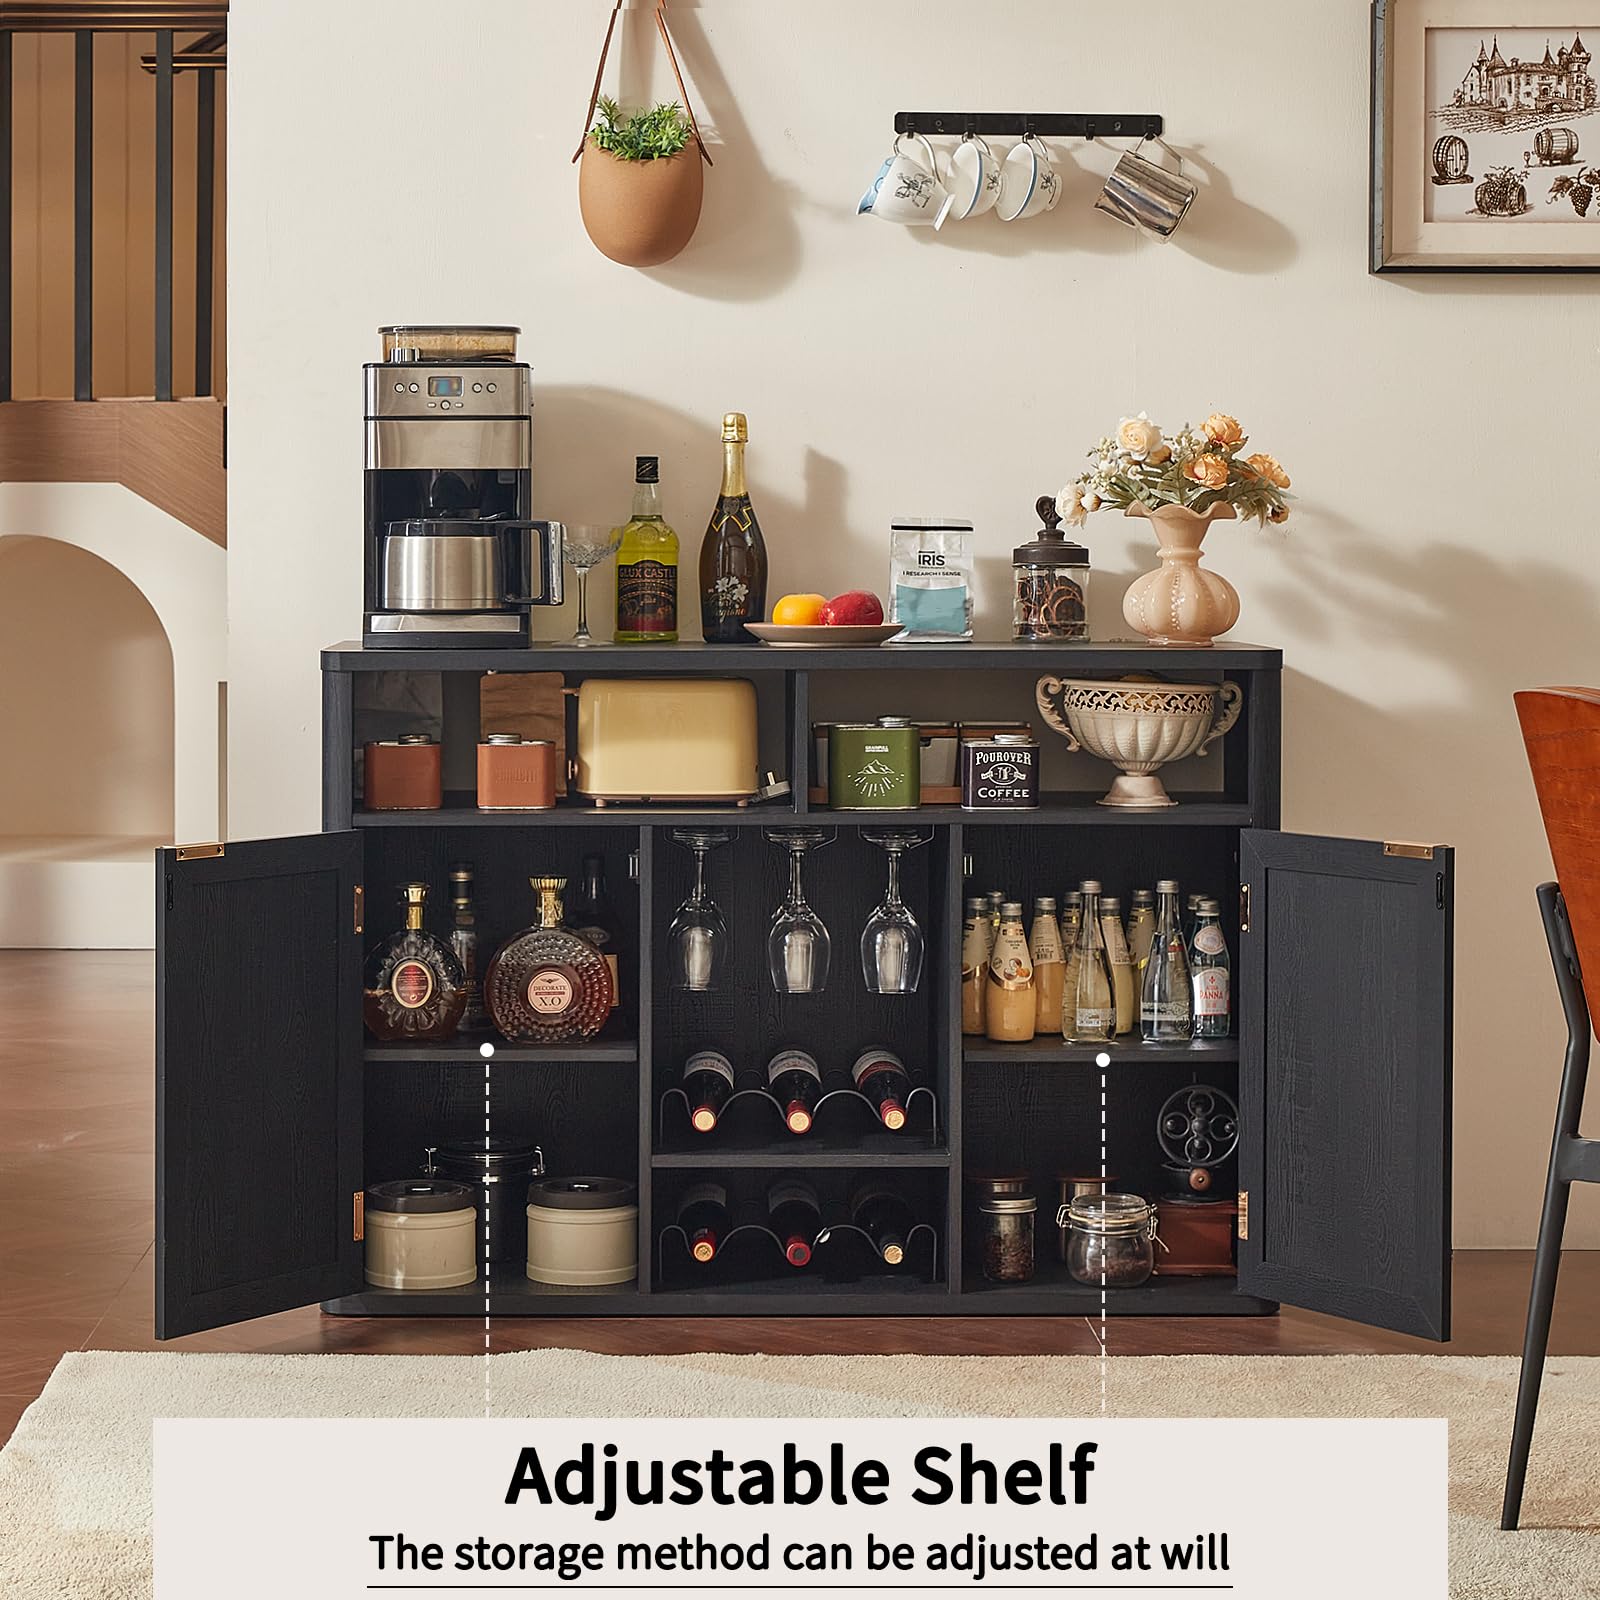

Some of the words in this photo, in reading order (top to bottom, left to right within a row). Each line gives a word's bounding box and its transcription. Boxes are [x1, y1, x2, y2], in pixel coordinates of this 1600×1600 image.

[918, 554, 946, 566] IRIS
[975, 751, 1033, 766] POUROVER
[977, 787, 1030, 799] COFFEE
[1199, 987, 1224, 1000] PANNA
[539, 996, 562, 1006] X.O
